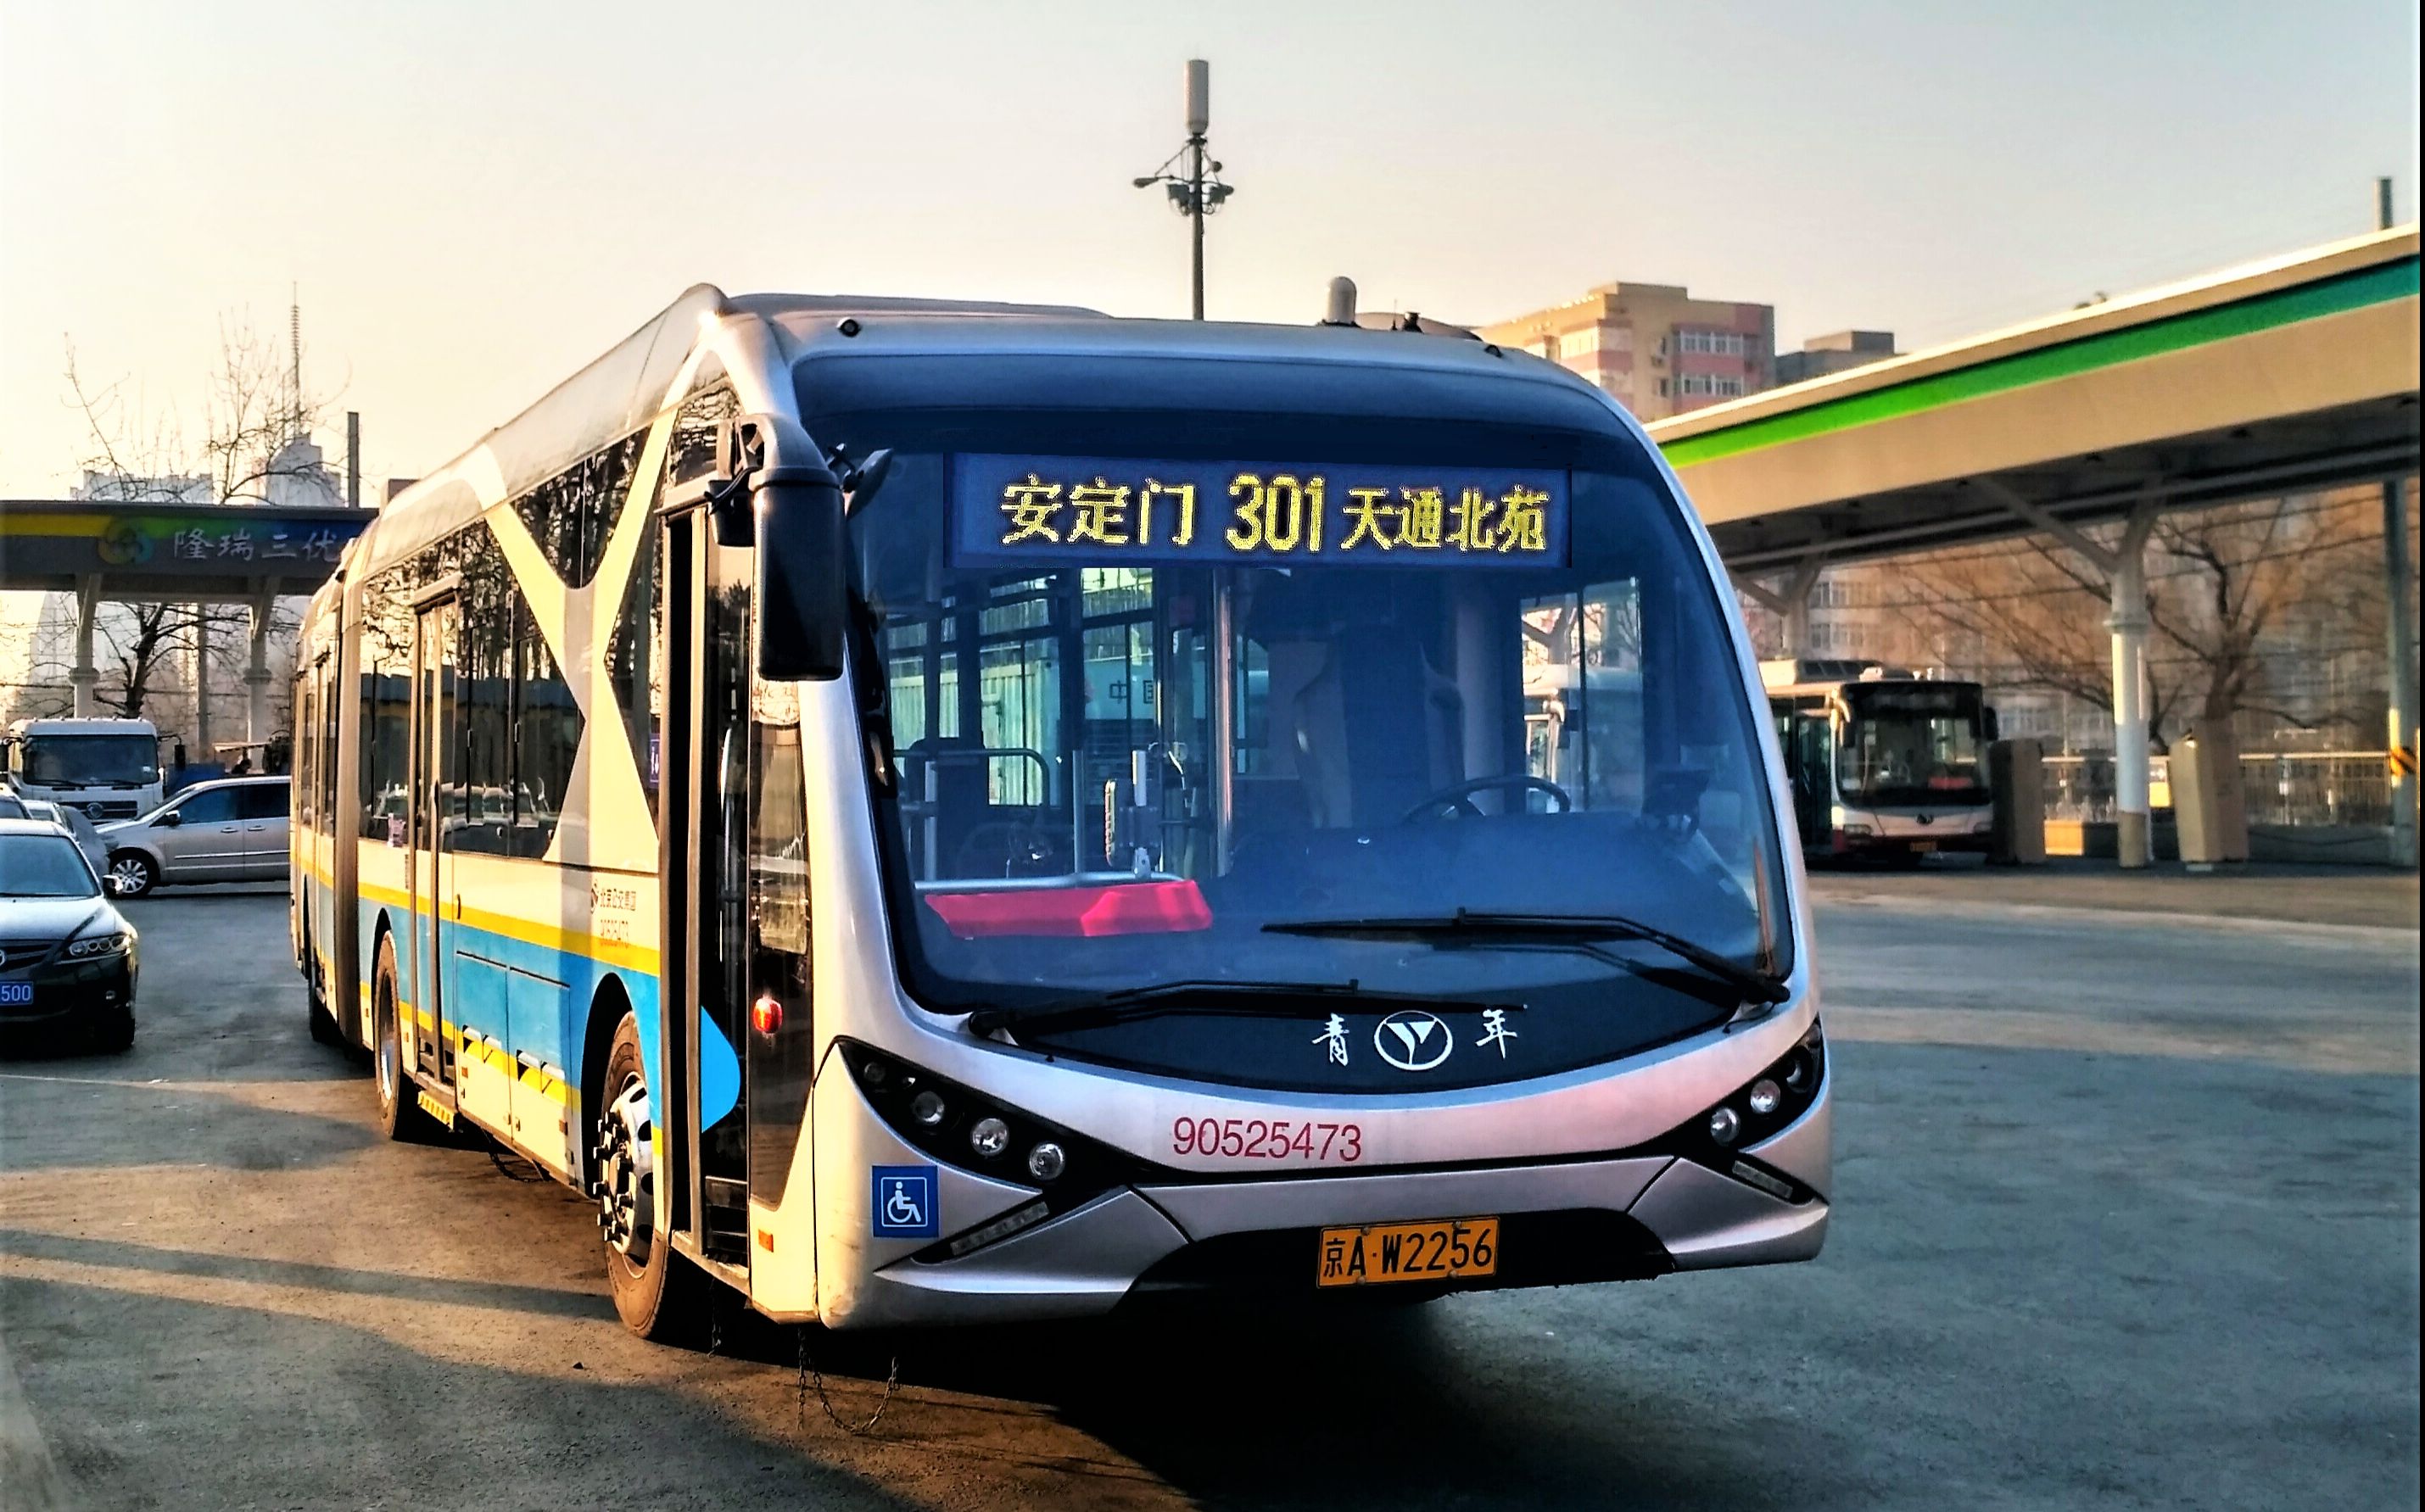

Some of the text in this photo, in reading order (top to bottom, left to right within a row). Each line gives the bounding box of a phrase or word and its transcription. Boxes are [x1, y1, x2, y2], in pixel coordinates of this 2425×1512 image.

[1000, 473, 1549, 552] 安定门 301 天通北苑
[1, 985, 31, 1001] 500
[1311, 1009, 1517, 1067] 青 年
[1173, 1116, 1361, 1162] 90525473
